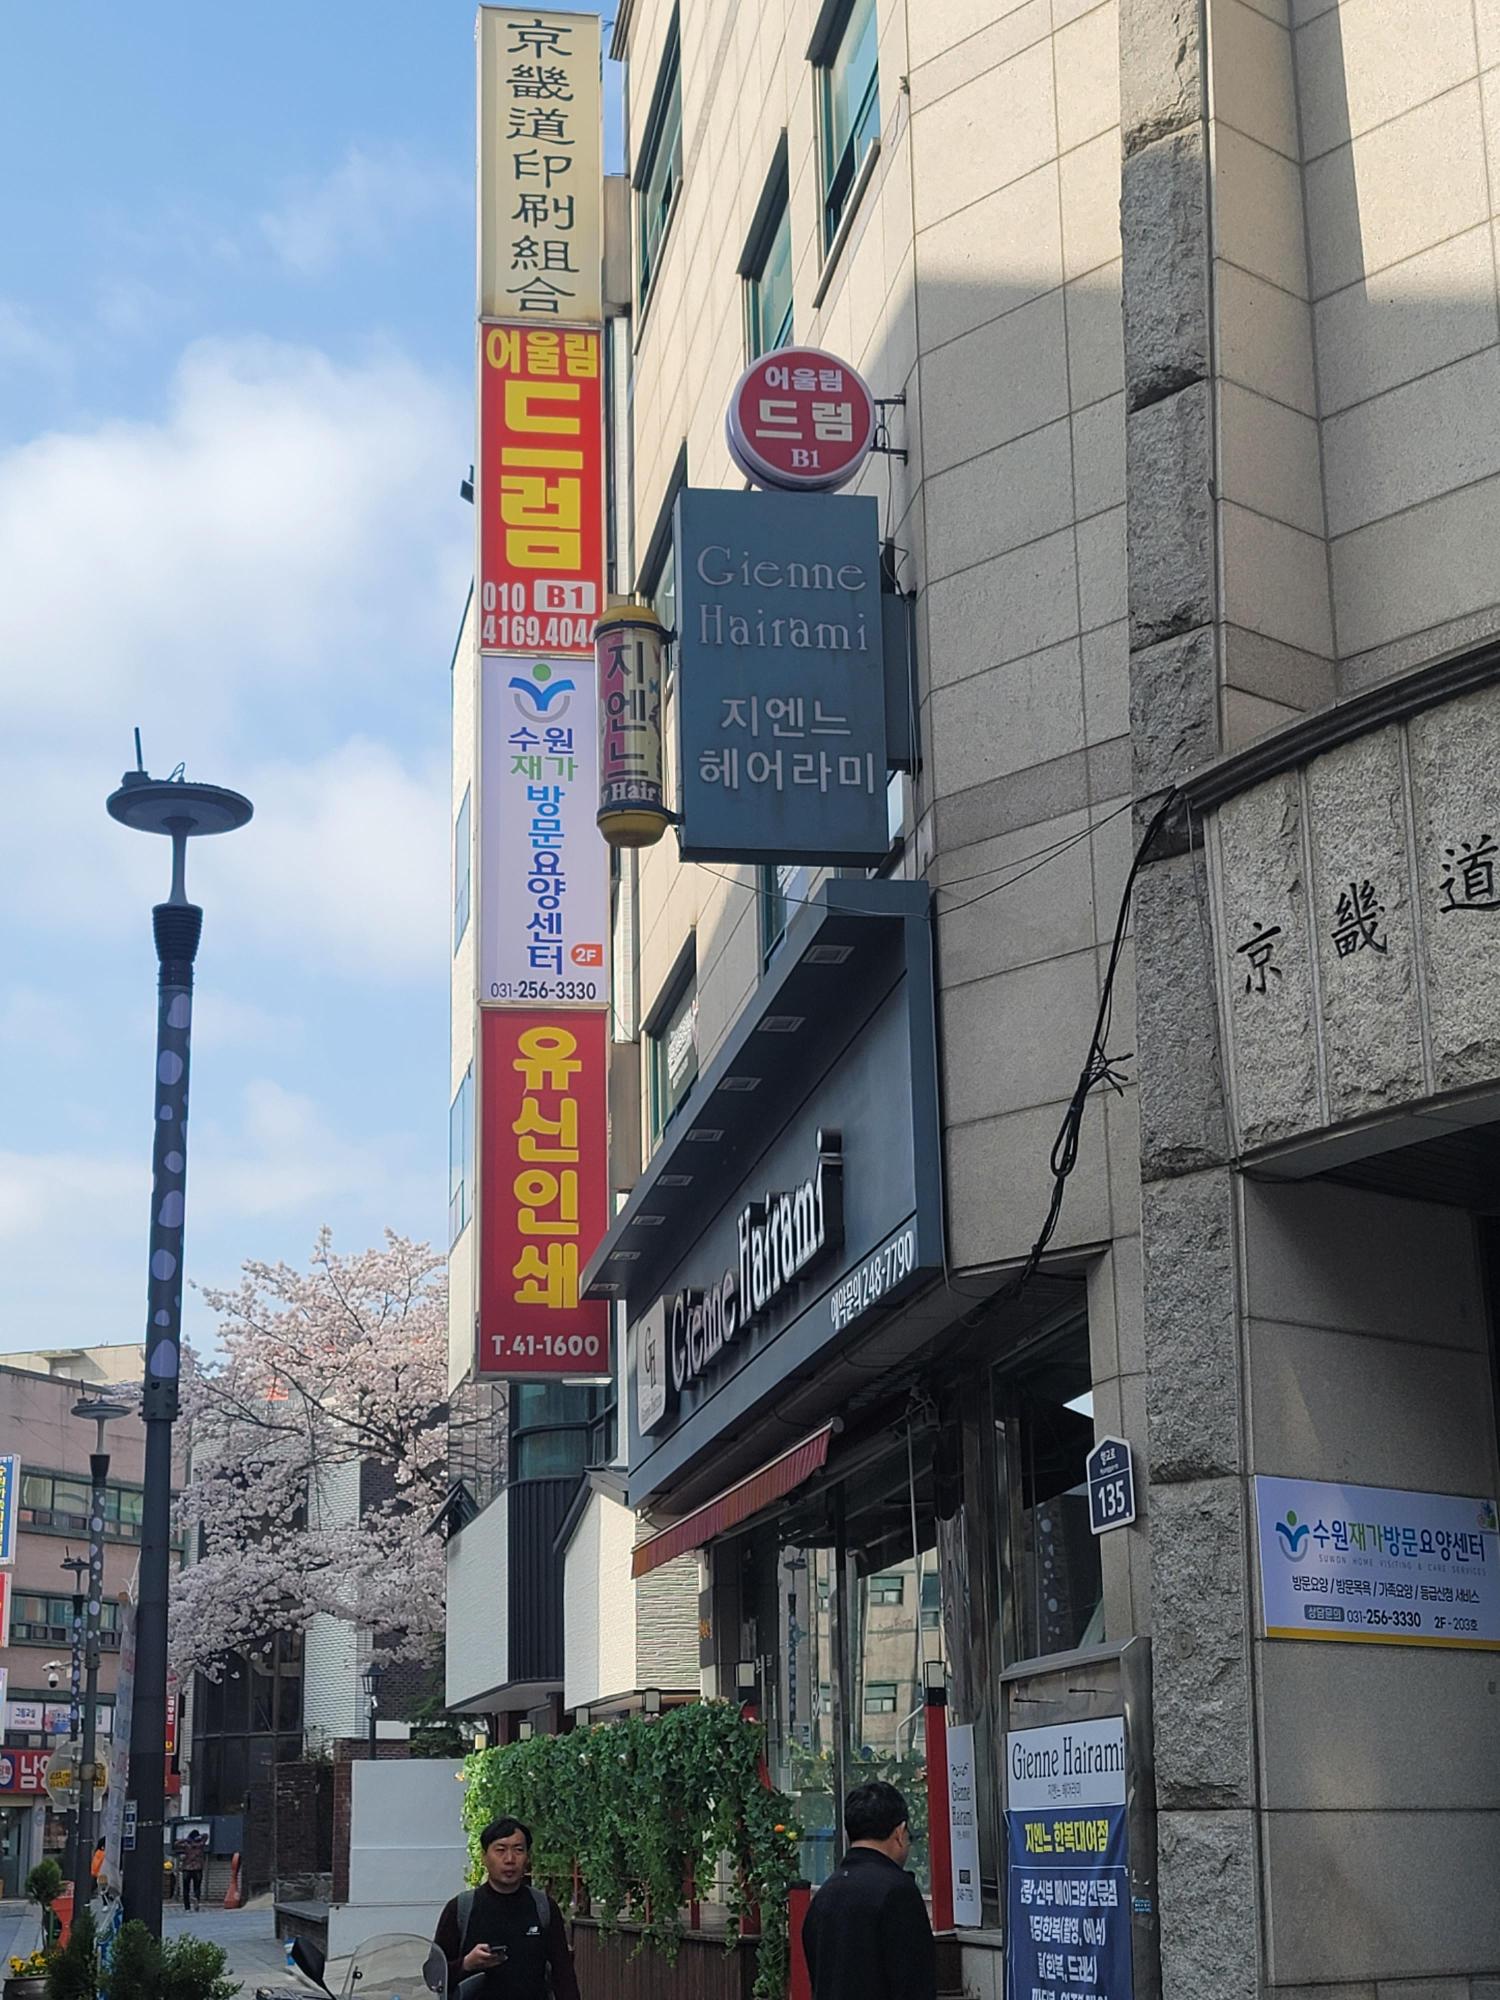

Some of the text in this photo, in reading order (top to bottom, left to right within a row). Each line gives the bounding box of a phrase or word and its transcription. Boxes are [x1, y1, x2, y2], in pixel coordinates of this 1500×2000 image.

[506, 19, 580, 314] 京畿道印刷組合
[487, 328, 598, 378] 어울림
[764, 366, 843, 393] 어울림
[790, 448, 821, 469] B1
[697, 545, 867, 591] Gienne
[483, 582, 583, 613] 010 B1
[700, 603, 869, 651] Hairami
[607, 640, 649, 779] 지엔느
[720, 696, 851, 738] 지엔느
[507, 727, 574, 754] 수원
[510, 755, 579, 782] 재가
[699, 748, 874, 794] 헤어라미
[611, 781, 656, 802] Hair
[526, 785, 566, 975] 방문요양센터
[575, 948, 597, 962] 2F
[490, 980, 597, 1000] 031-256-3330
[512, 1026, 582, 1309] 유신인쇄
[672, 1127, 832, 1392] Gienne Hairami
[830, 1271, 862, 1330] 예약문의
[1098, 1480, 1126, 1518] 135
[1313, 1519, 1486, 1563] 수원재가방문요양센터
[1346, 1608, 1421, 1628] 031-256-3330
[1434, 1615, 1446, 1629] 2F
[1012, 1736, 1124, 1780] Gienne Hairami
[1025, 1823, 1053, 1853] 지엔느
